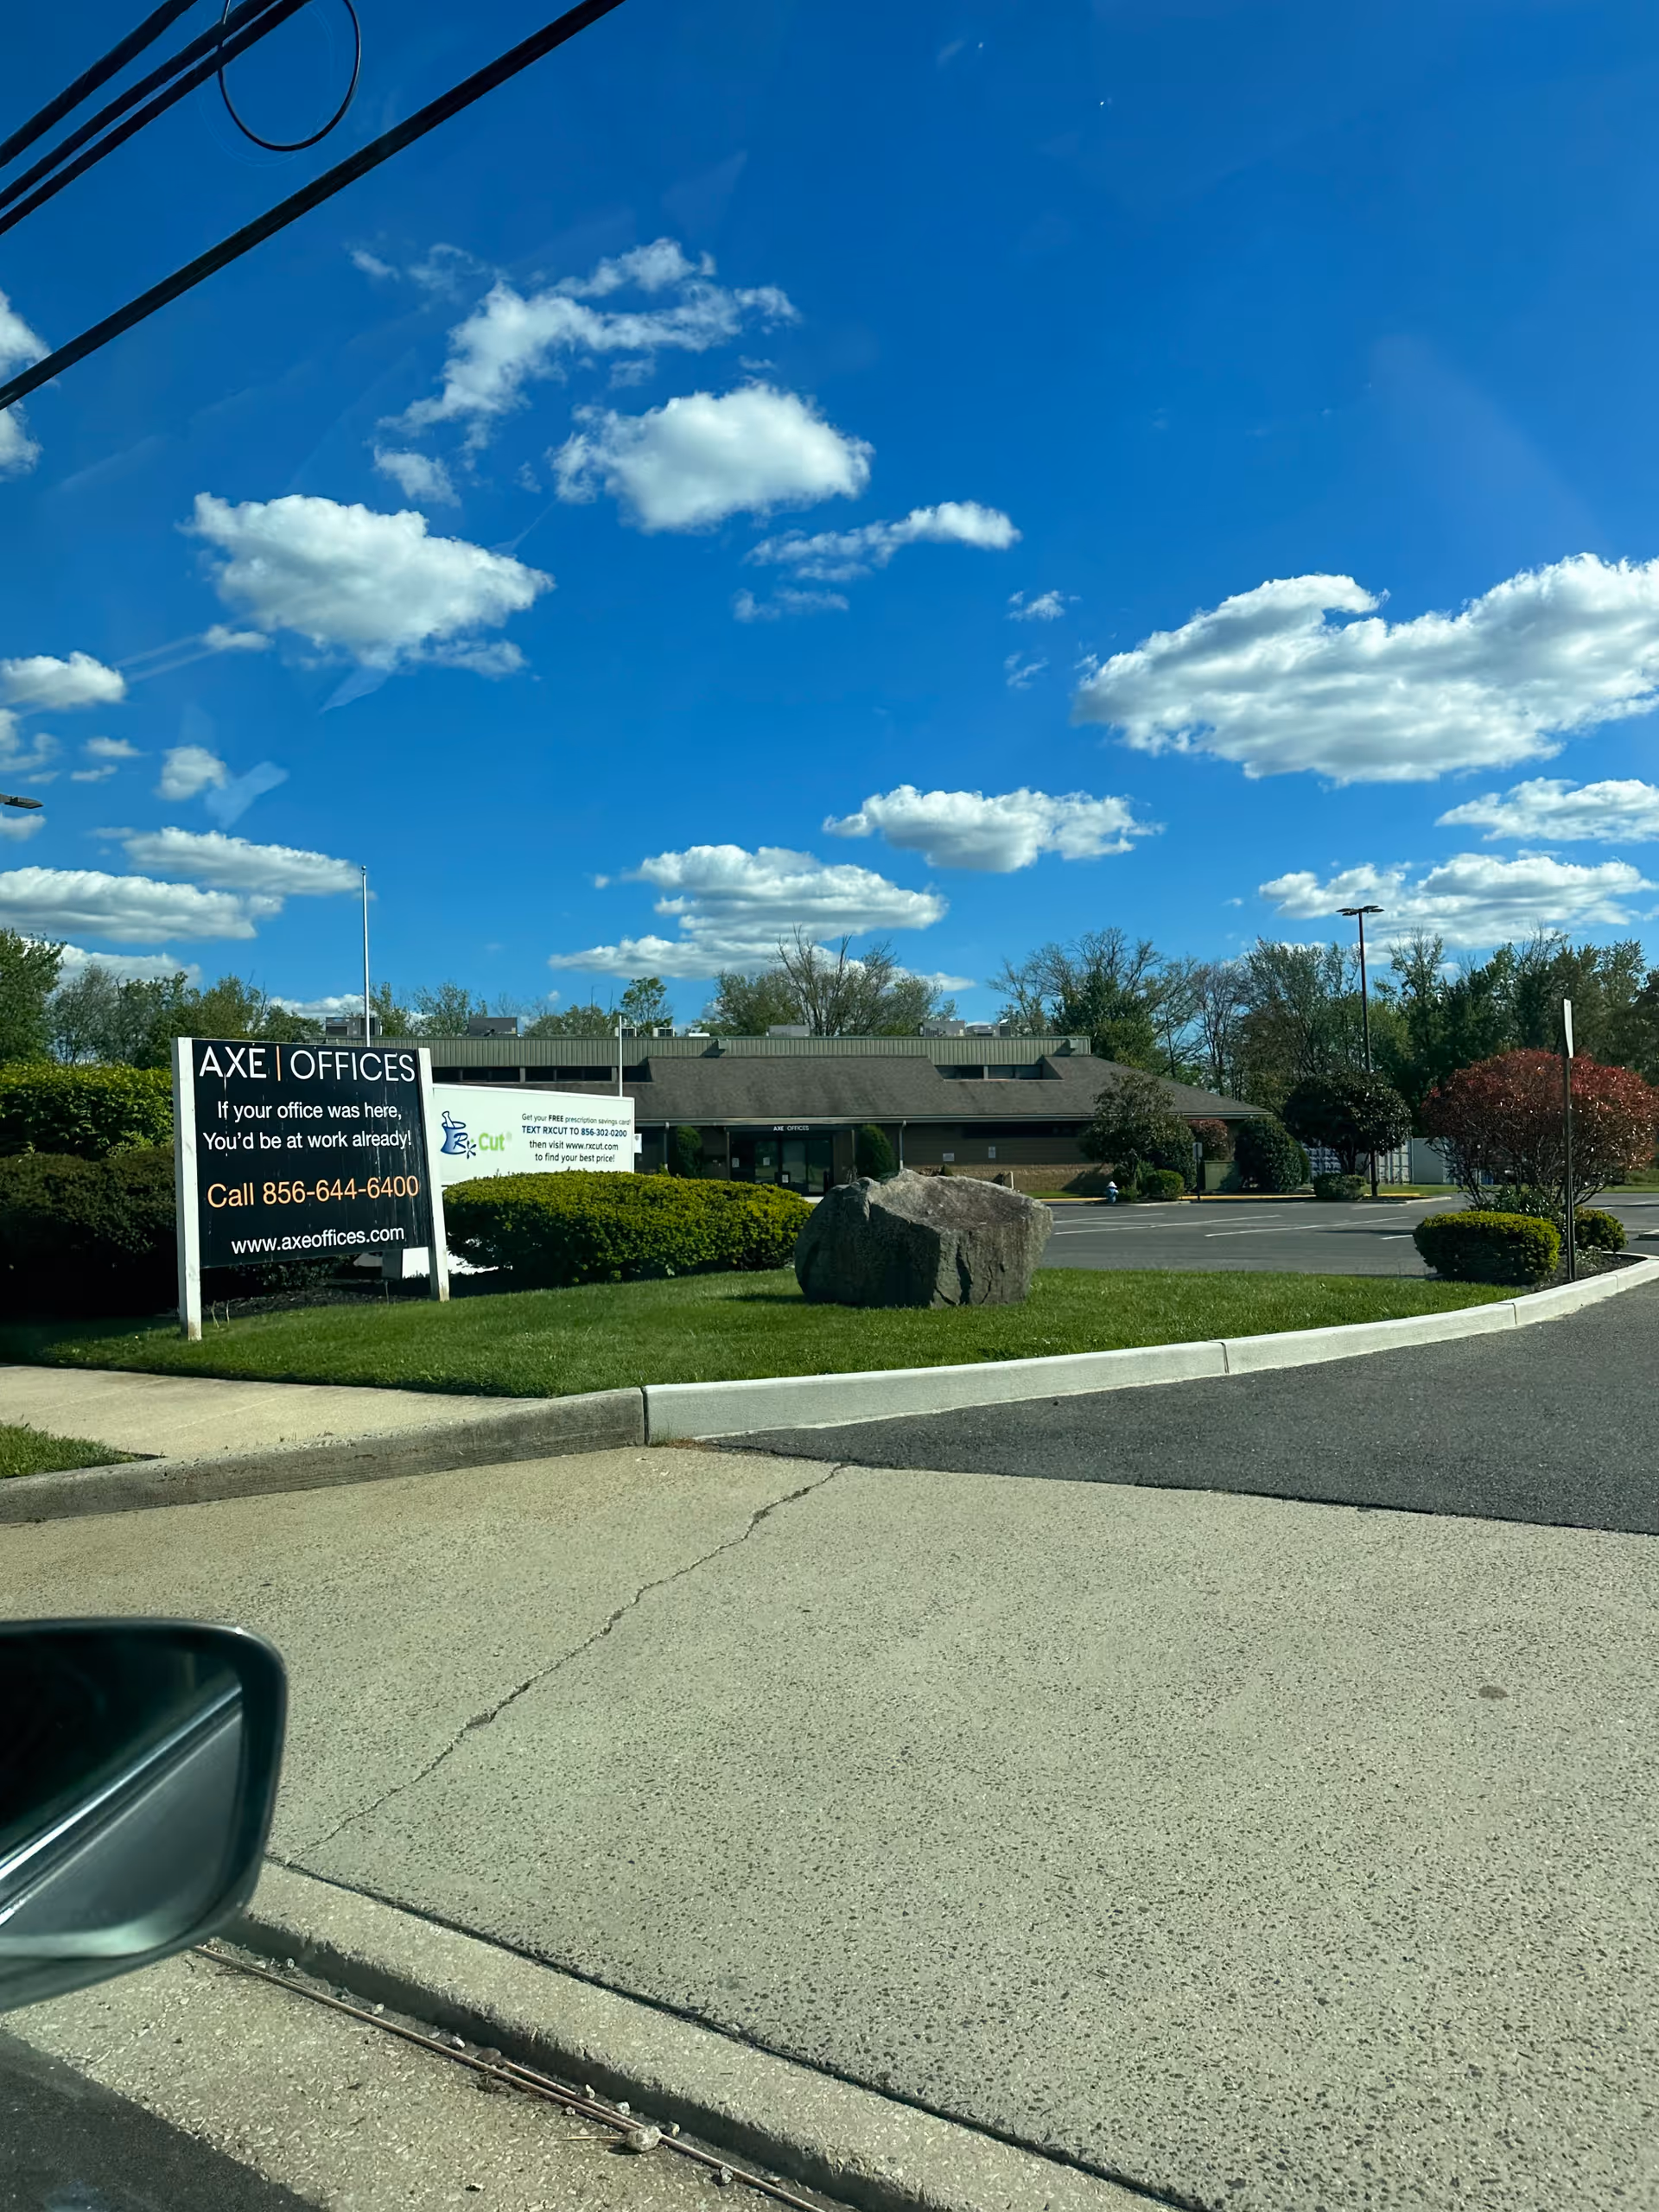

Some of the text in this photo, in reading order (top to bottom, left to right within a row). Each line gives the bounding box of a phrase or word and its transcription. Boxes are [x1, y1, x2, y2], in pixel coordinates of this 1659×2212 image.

[199, 1046, 416, 1082] AXE OFFICES
[218, 1100, 402, 1122] If your office was here,
[565, 1116, 597, 1124] prescription
[598, 1117, 618, 1126] savings
[202, 1130, 412, 1150] You’d be at work already!
[522, 1125, 627, 1137] TEXT RXCUT TO 856-302-0200
[478, 1132, 505, 1151] Cut
[529, 1140, 619, 1151] then visit www.rxcut.com
[544, 1153, 559, 1161] find
[561, 1154, 577, 1164] your
[579, 1154, 594, 1162] best
[596, 1154, 615, 1164] price!
[207, 1175, 419, 1208] Call 856-644-6400
[232, 1226, 405, 1255] www.axeoffices.com
